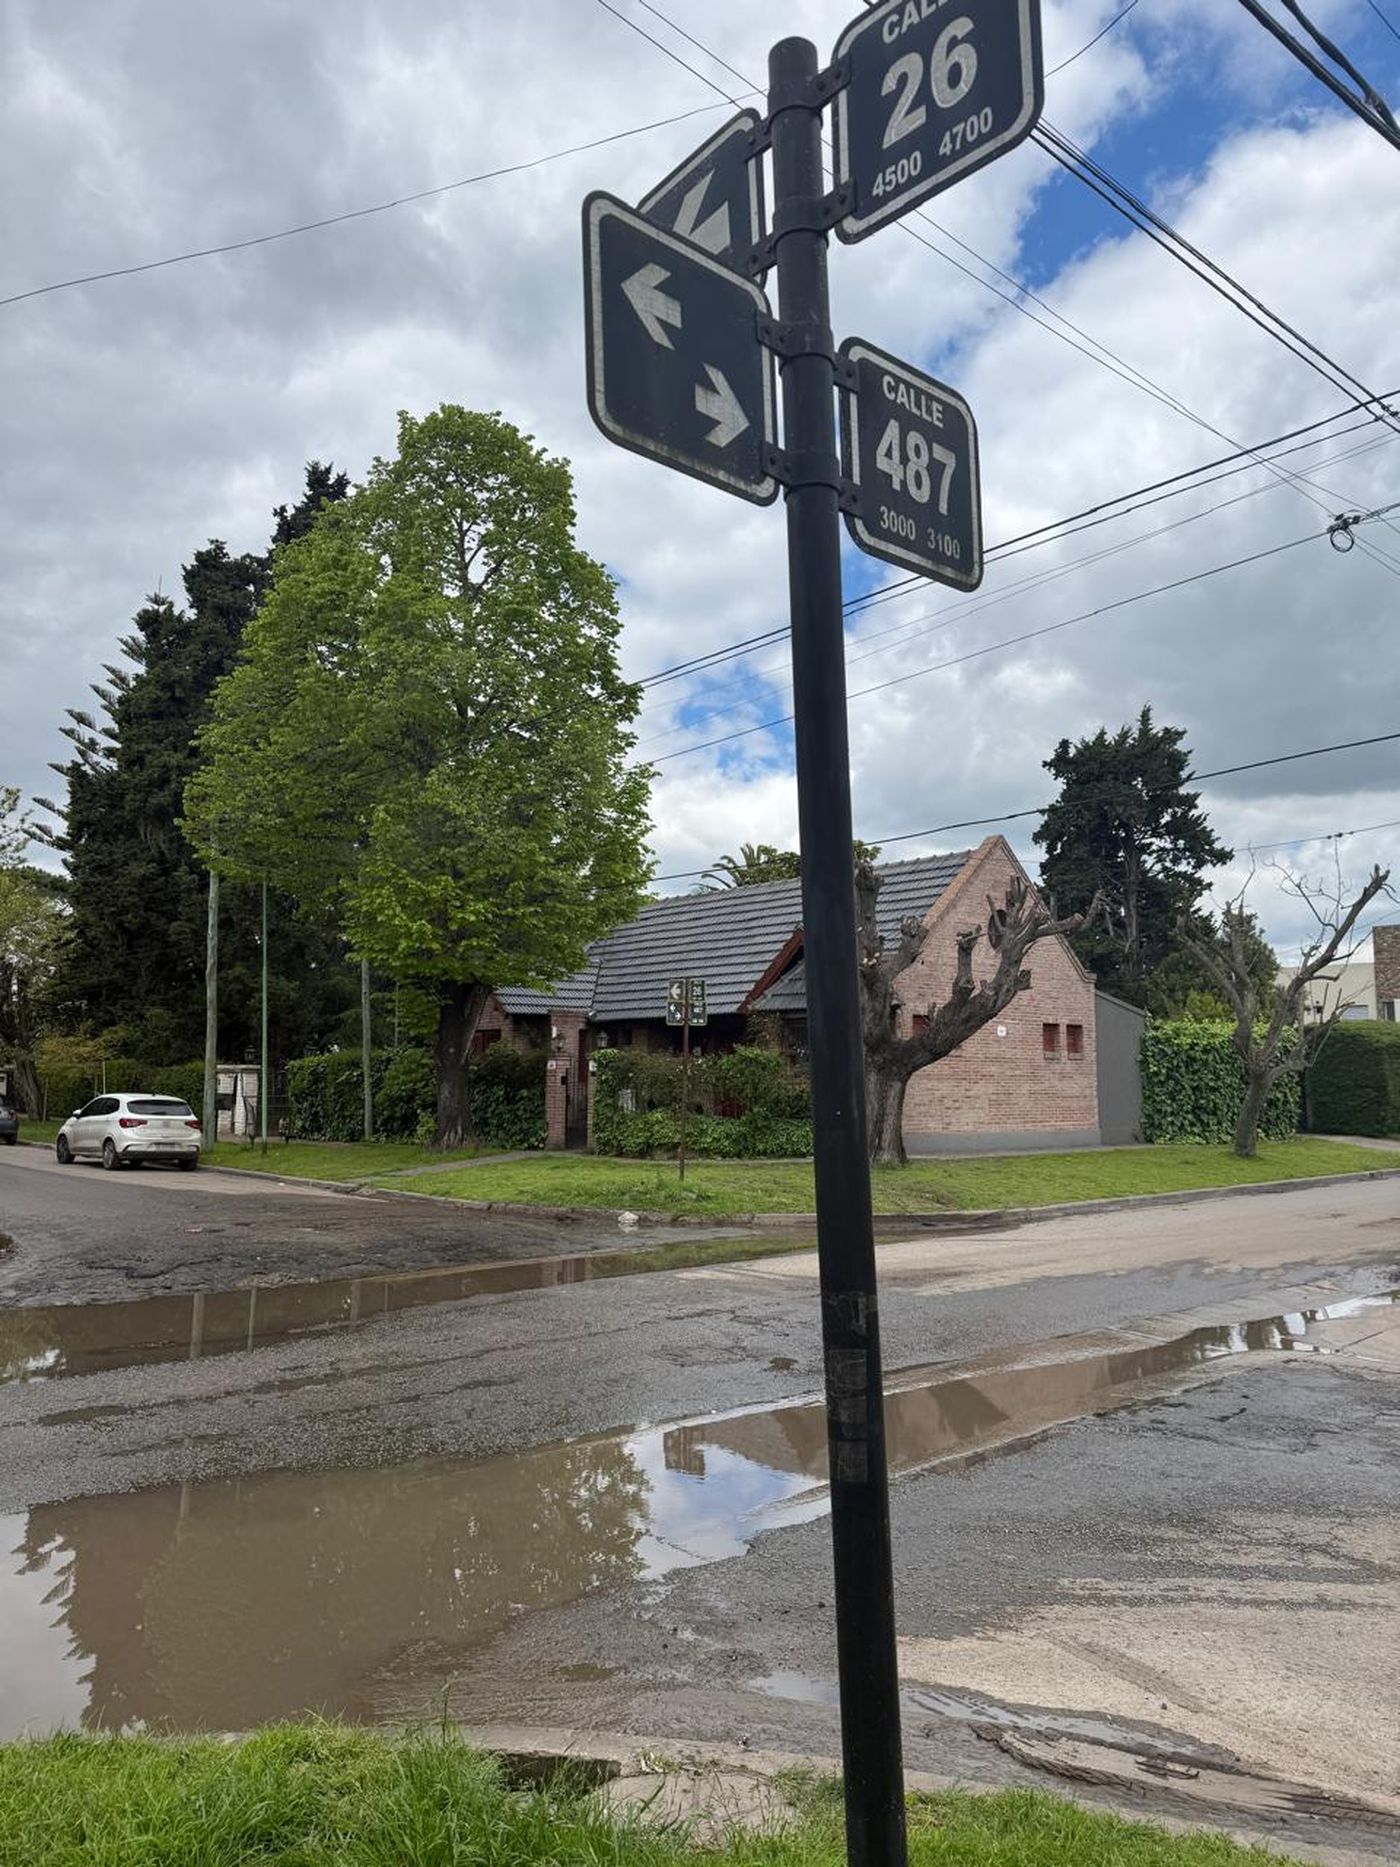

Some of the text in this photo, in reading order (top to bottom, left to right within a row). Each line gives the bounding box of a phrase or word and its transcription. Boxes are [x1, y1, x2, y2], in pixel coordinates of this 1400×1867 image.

[882, 0, 949, 44] CAL
[881, 16, 977, 149] 26
[872, 106, 993, 197] 4500 4700
[882, 375, 944, 428] CALLE
[876, 418, 956, 516] 487
[880, 506, 960, 560] 3000 3100
